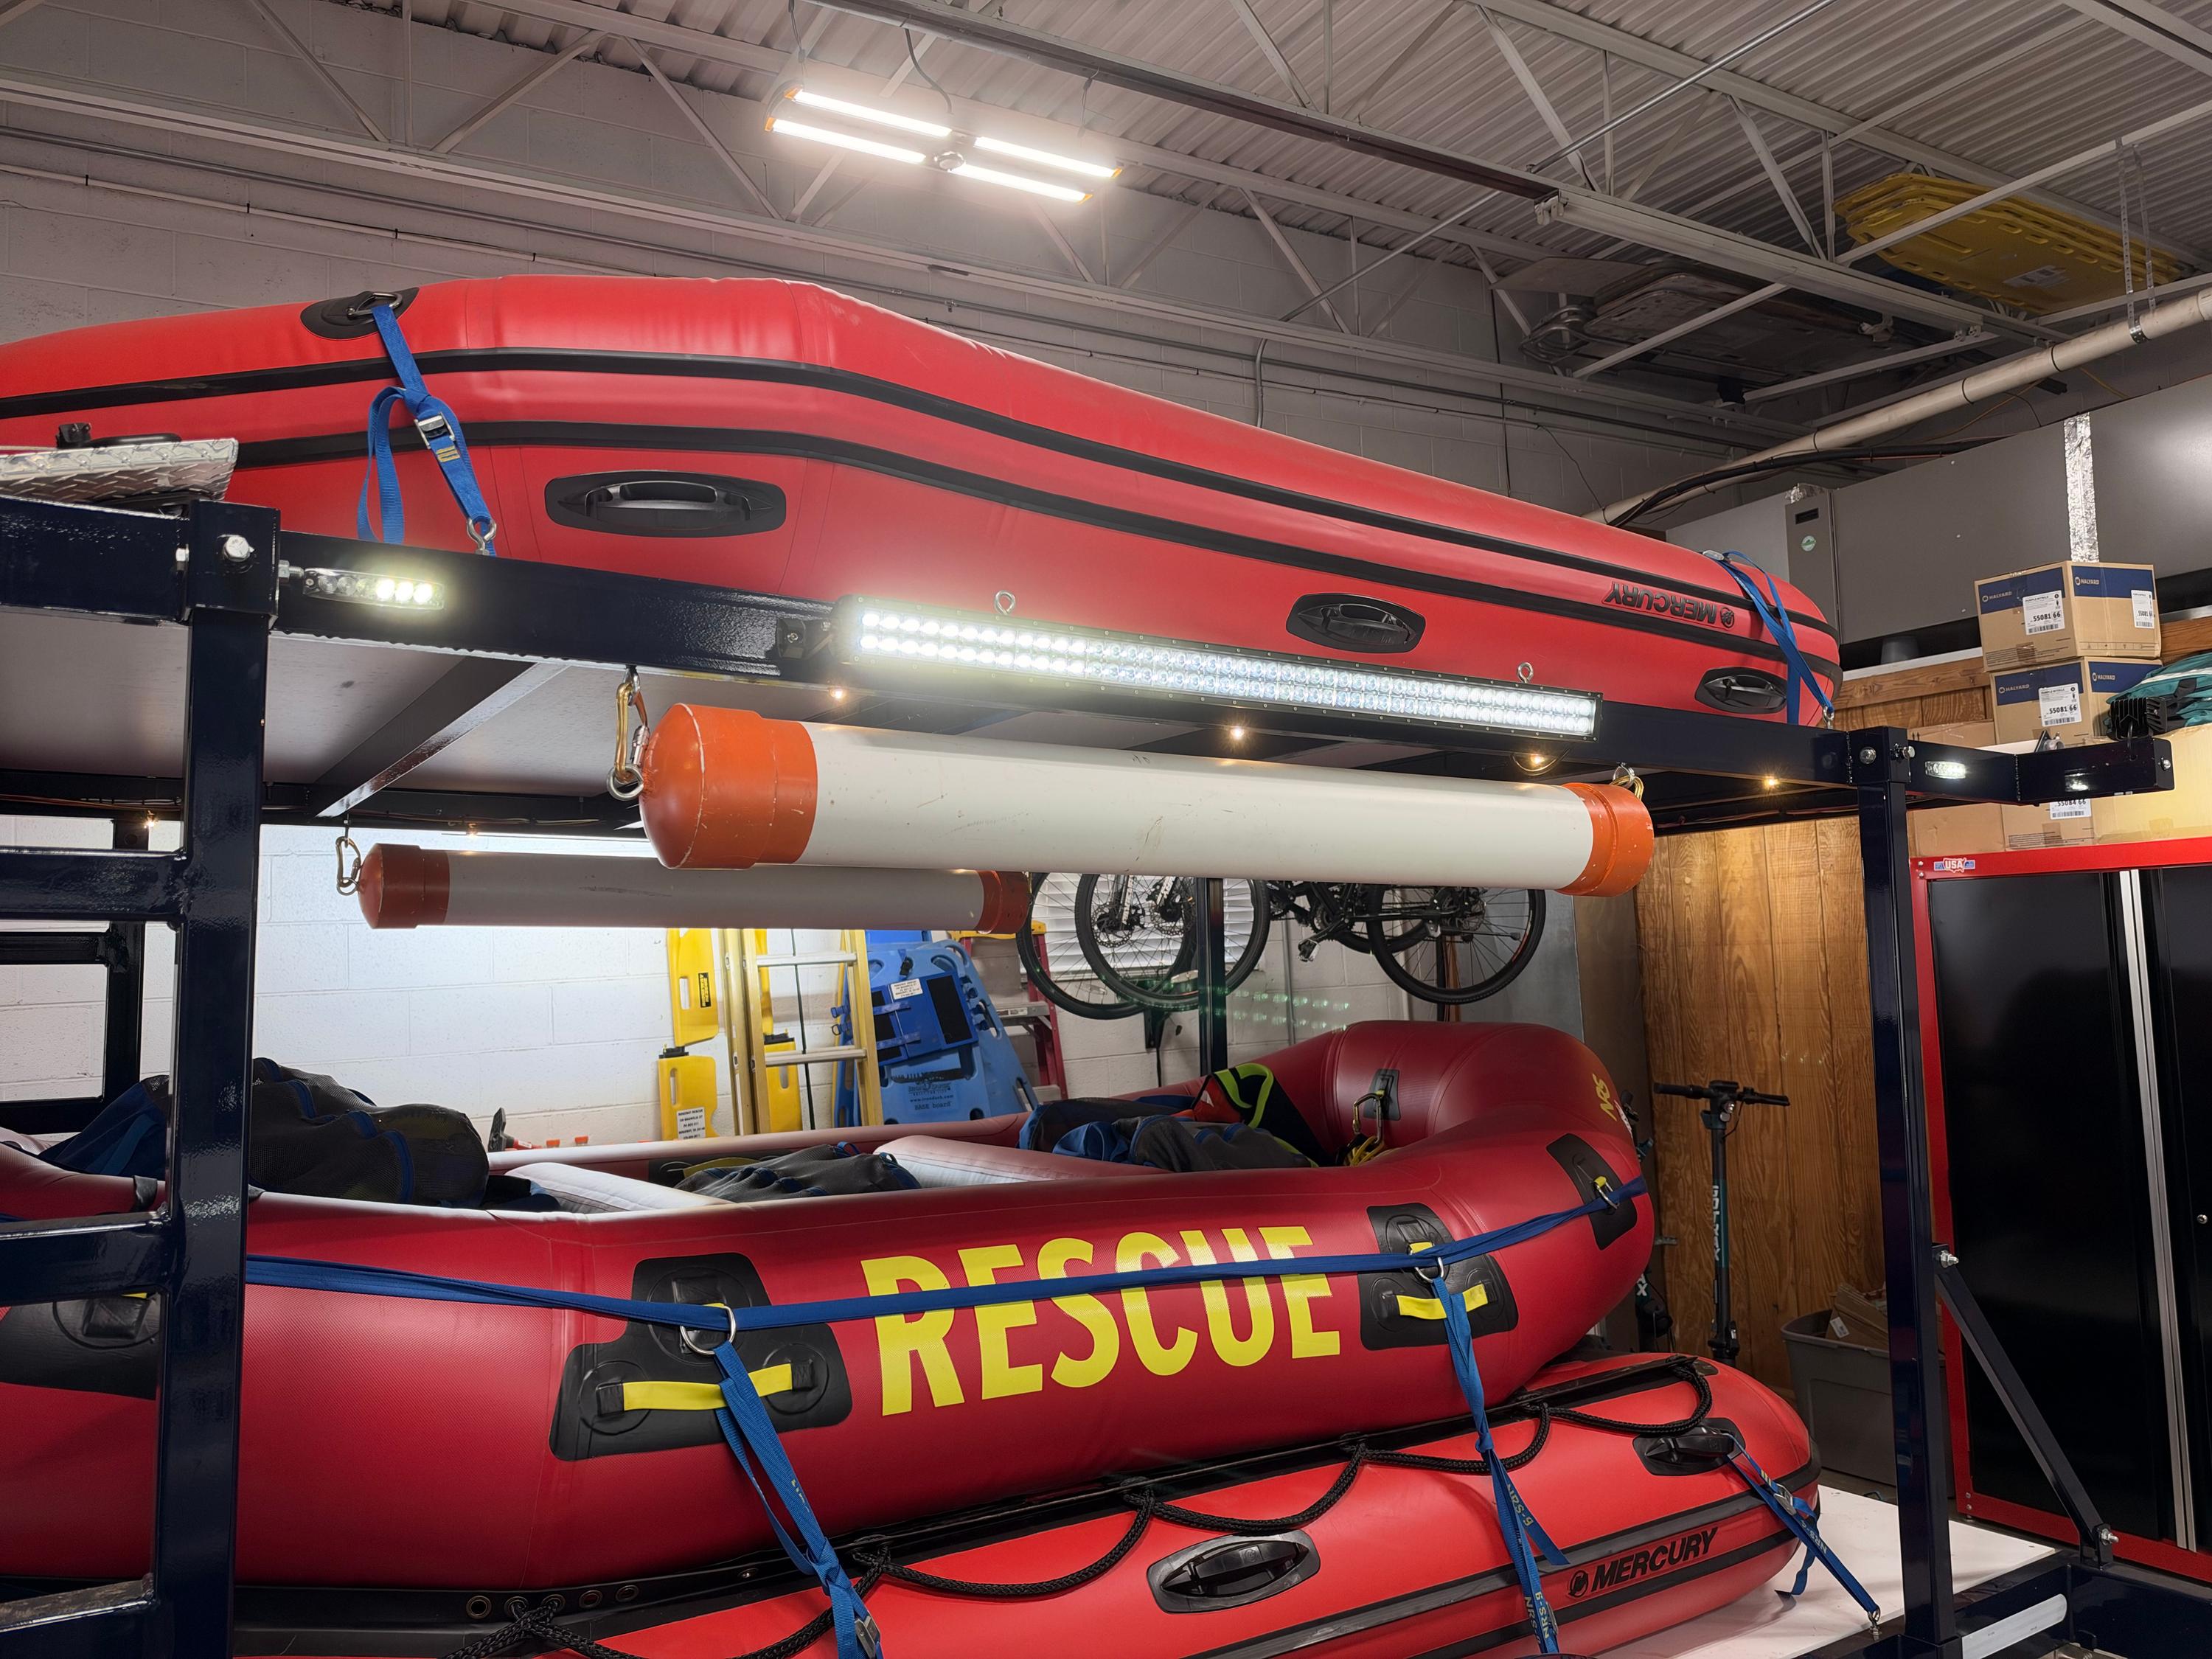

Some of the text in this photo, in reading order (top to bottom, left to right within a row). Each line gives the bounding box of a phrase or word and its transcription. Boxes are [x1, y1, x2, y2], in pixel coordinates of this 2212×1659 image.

[1604, 581, 1717, 625] MERCURY
[2033, 613, 2051, 622] 55081
[1945, 860, 1963, 869] USA
[860, 1225, 1340, 1416] RESCUE
[1592, 1528, 1718, 1591] MERCURY
